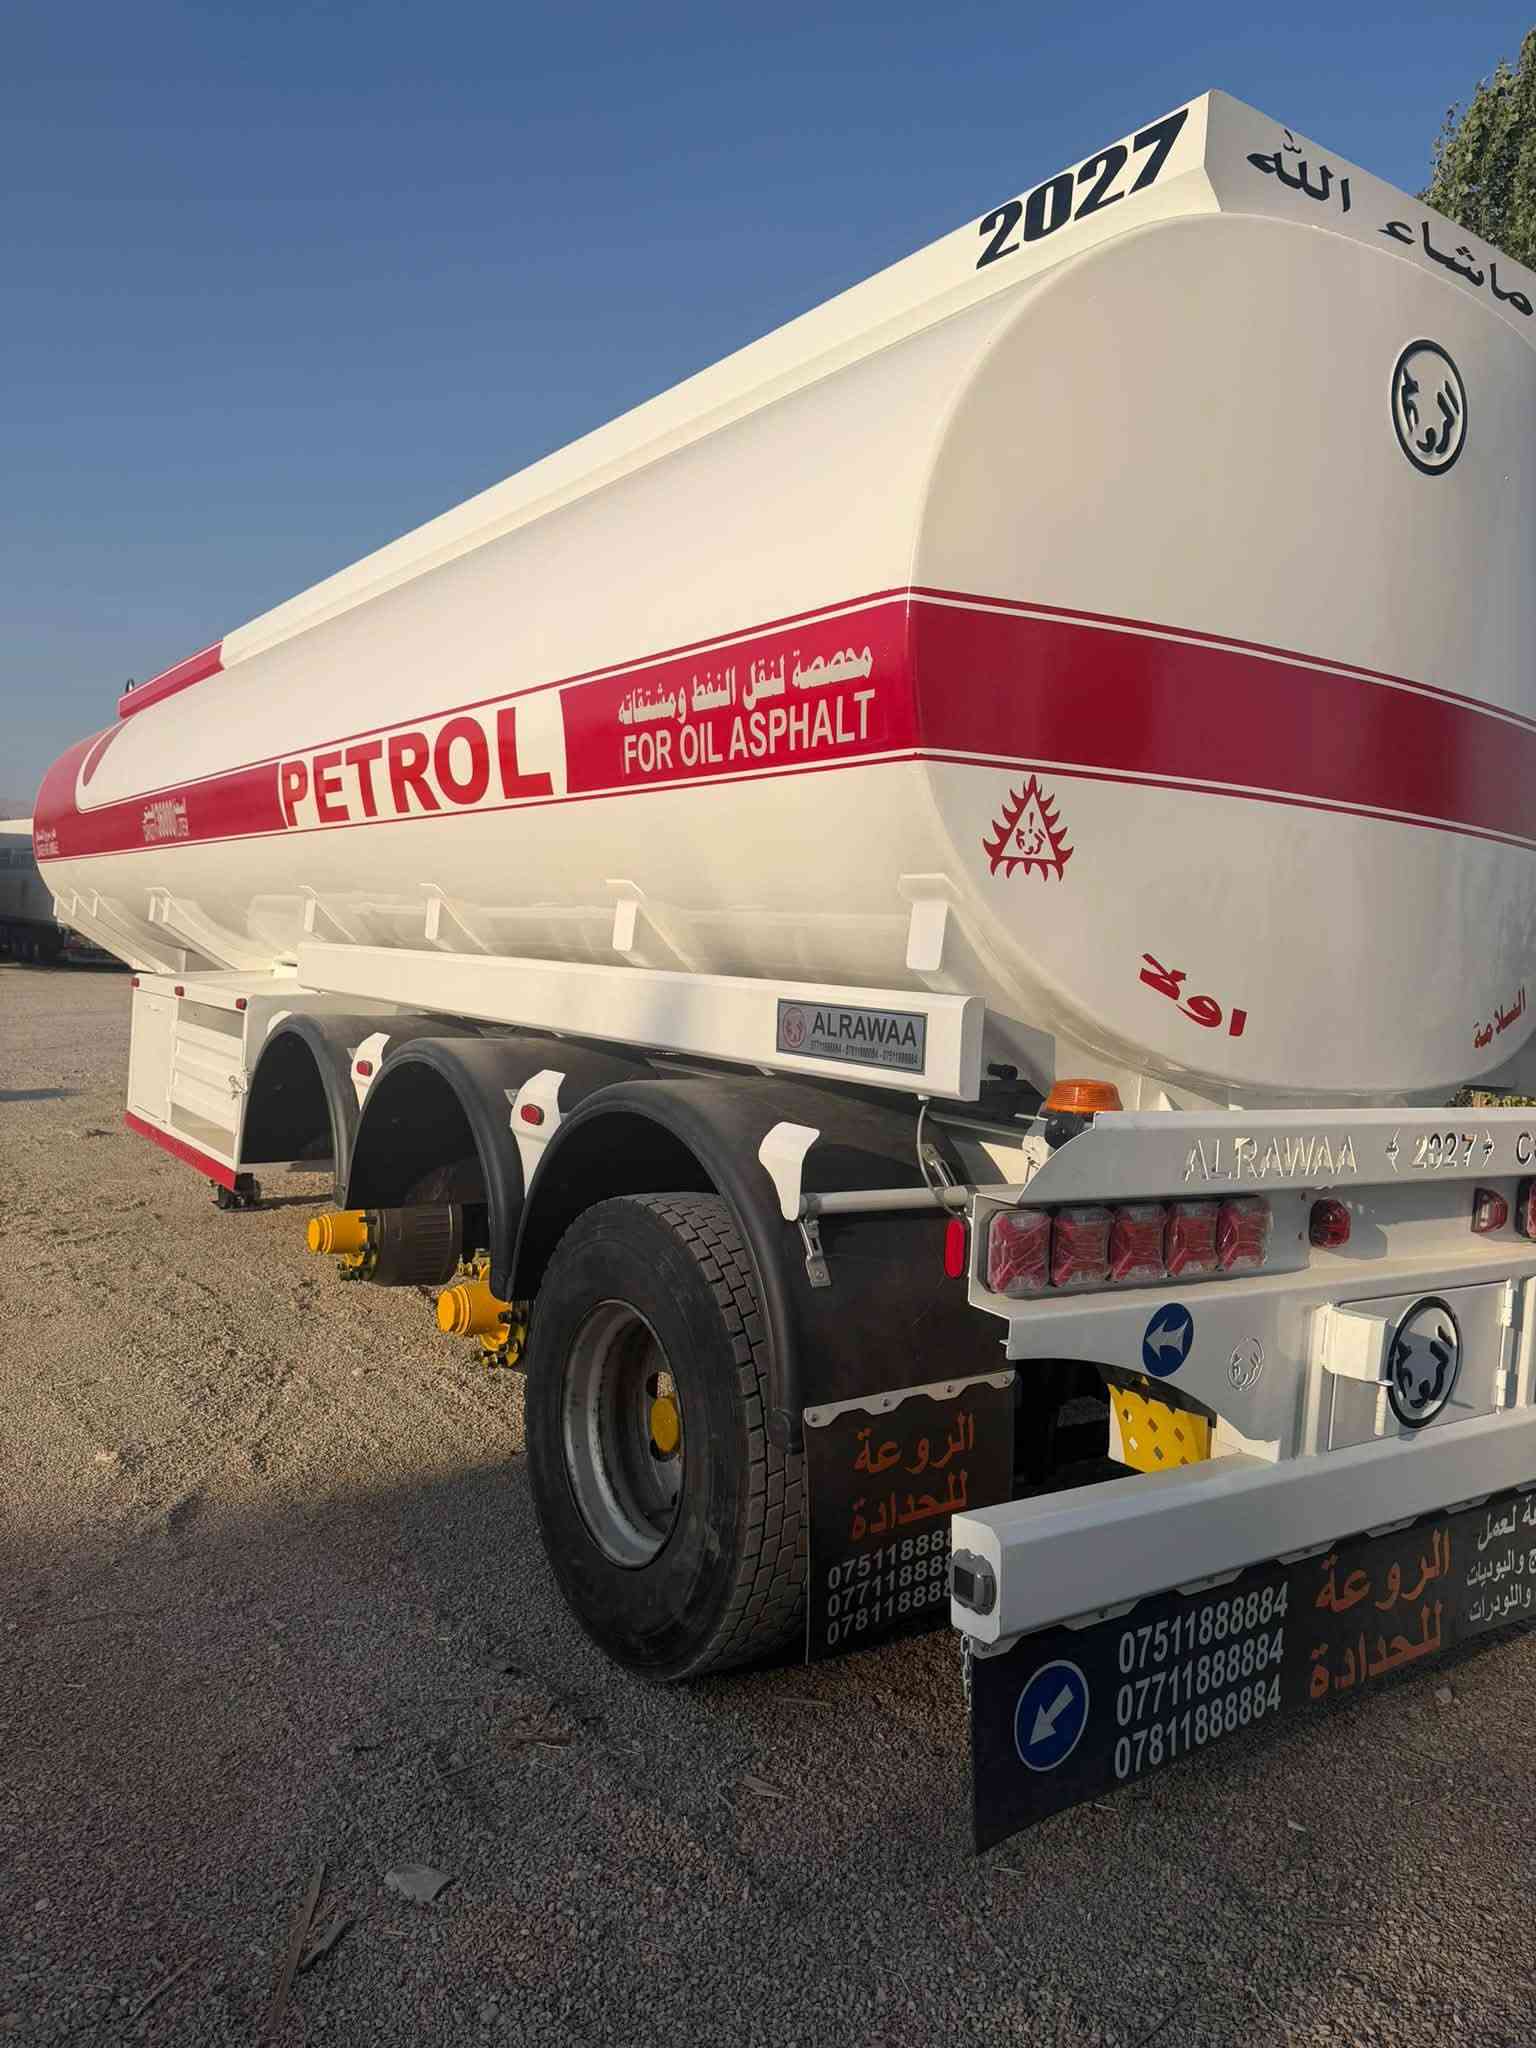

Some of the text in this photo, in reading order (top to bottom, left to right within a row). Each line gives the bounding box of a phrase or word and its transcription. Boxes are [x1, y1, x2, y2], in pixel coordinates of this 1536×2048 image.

[976, 108, 1190, 270] 2027
[691, 665, 736, 713] النفط
[742, 654, 786, 711] لنقل
[282, 706, 555, 827] PETROL
[623, 688, 876, 775] FOR OIL ASPHALT
[812, 1010, 917, 1048] ALRAWAA
[1474, 985, 1526, 1049] السلامة
[1185, 1135, 1358, 1182] ALRAWAA
[1118, 1581, 1289, 1674] 07511888884
[1116, 1627, 1284, 1727] 07711888884
[1114, 1673, 1281, 1779] 07811888884
